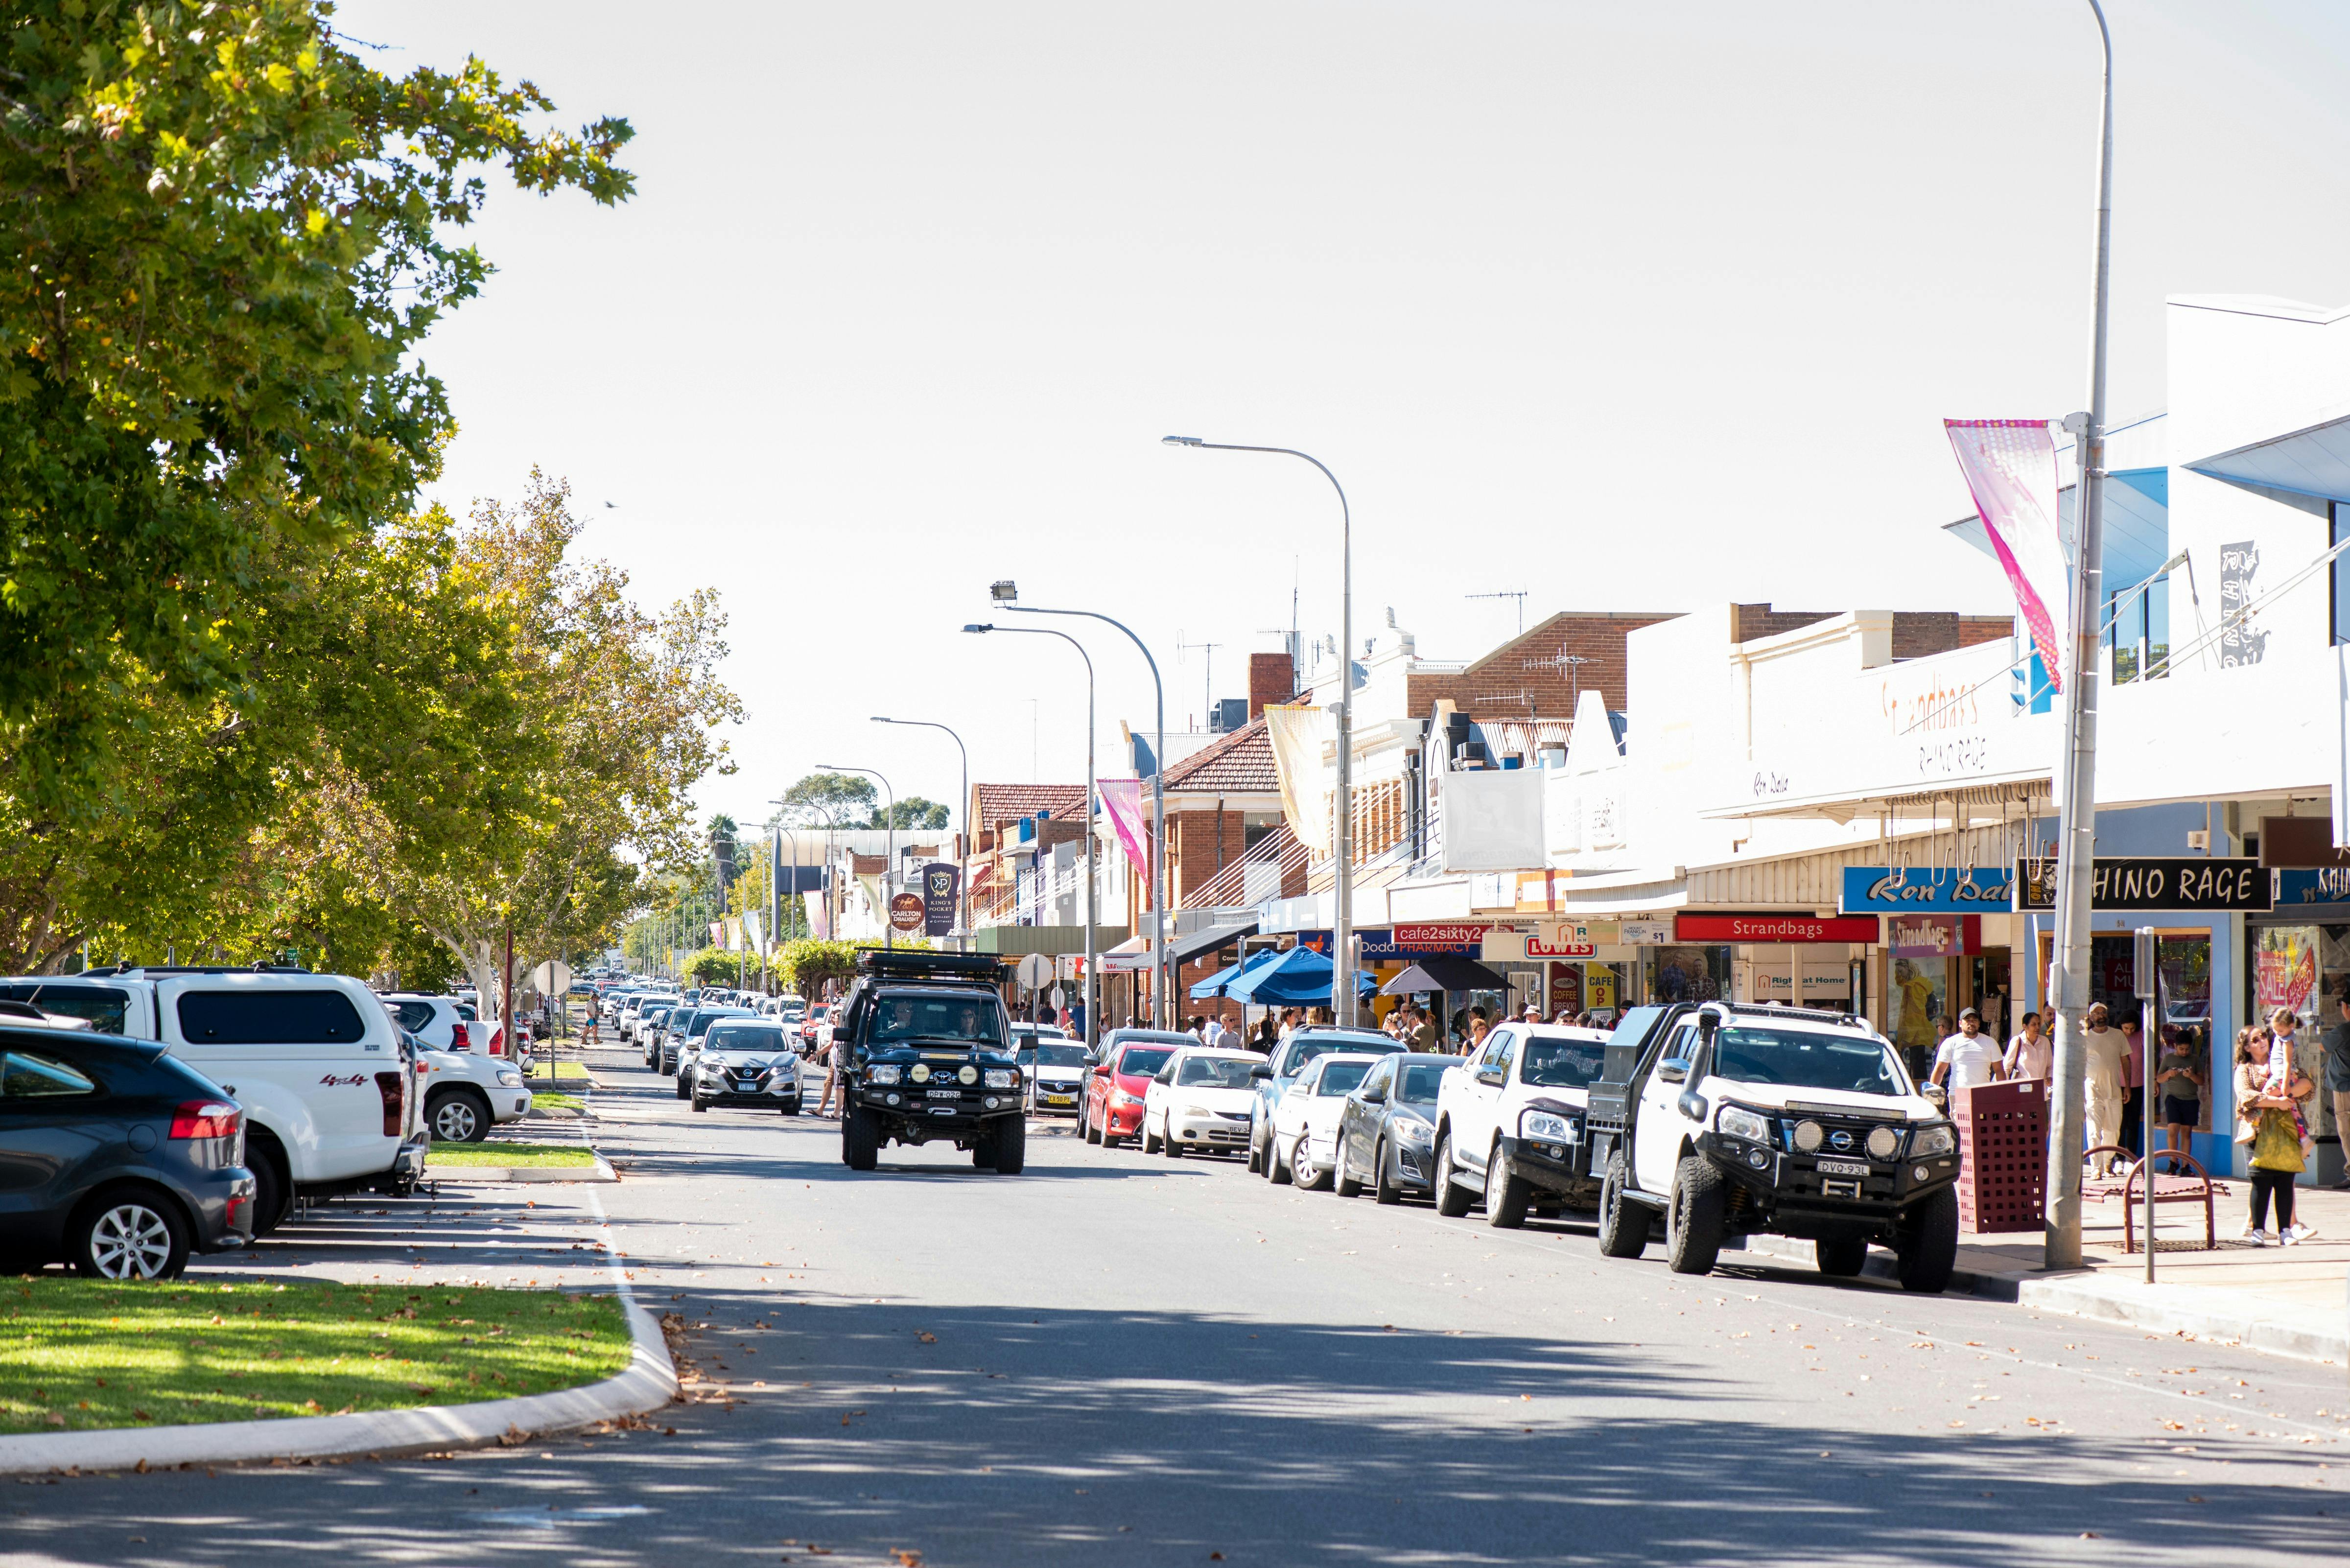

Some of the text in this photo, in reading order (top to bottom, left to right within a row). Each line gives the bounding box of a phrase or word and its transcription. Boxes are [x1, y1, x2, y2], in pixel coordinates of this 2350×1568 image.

[1881, 669, 1978, 736] Standbags
[1959, 735, 1987, 772] RAGE
[1866, 874, 2013, 903] Ron Dal
[2092, 866, 2252, 903] HINO RAGE
[1400, 926, 1481, 942] cafe2sixty2
[1733, 920, 1823, 938] Strandbags
[1897, 919, 1949, 953] Strandbags
[1653, 932, 1664, 943] $1
[1361, 941, 1470, 952] Dodd PHARMACY
[1531, 941, 1590, 953] LOWES
[1589, 977, 1612, 986] CAFE
[1772, 977, 1792, 986] Righ
[2259, 970, 2285, 1000] SALE
[2303, 969, 2312, 989] GO
[1553, 990, 1577, 1000] COFFEE
[1554, 1002, 1576, 1011] BREKKI
[319, 1073, 369, 1087] 4x4
